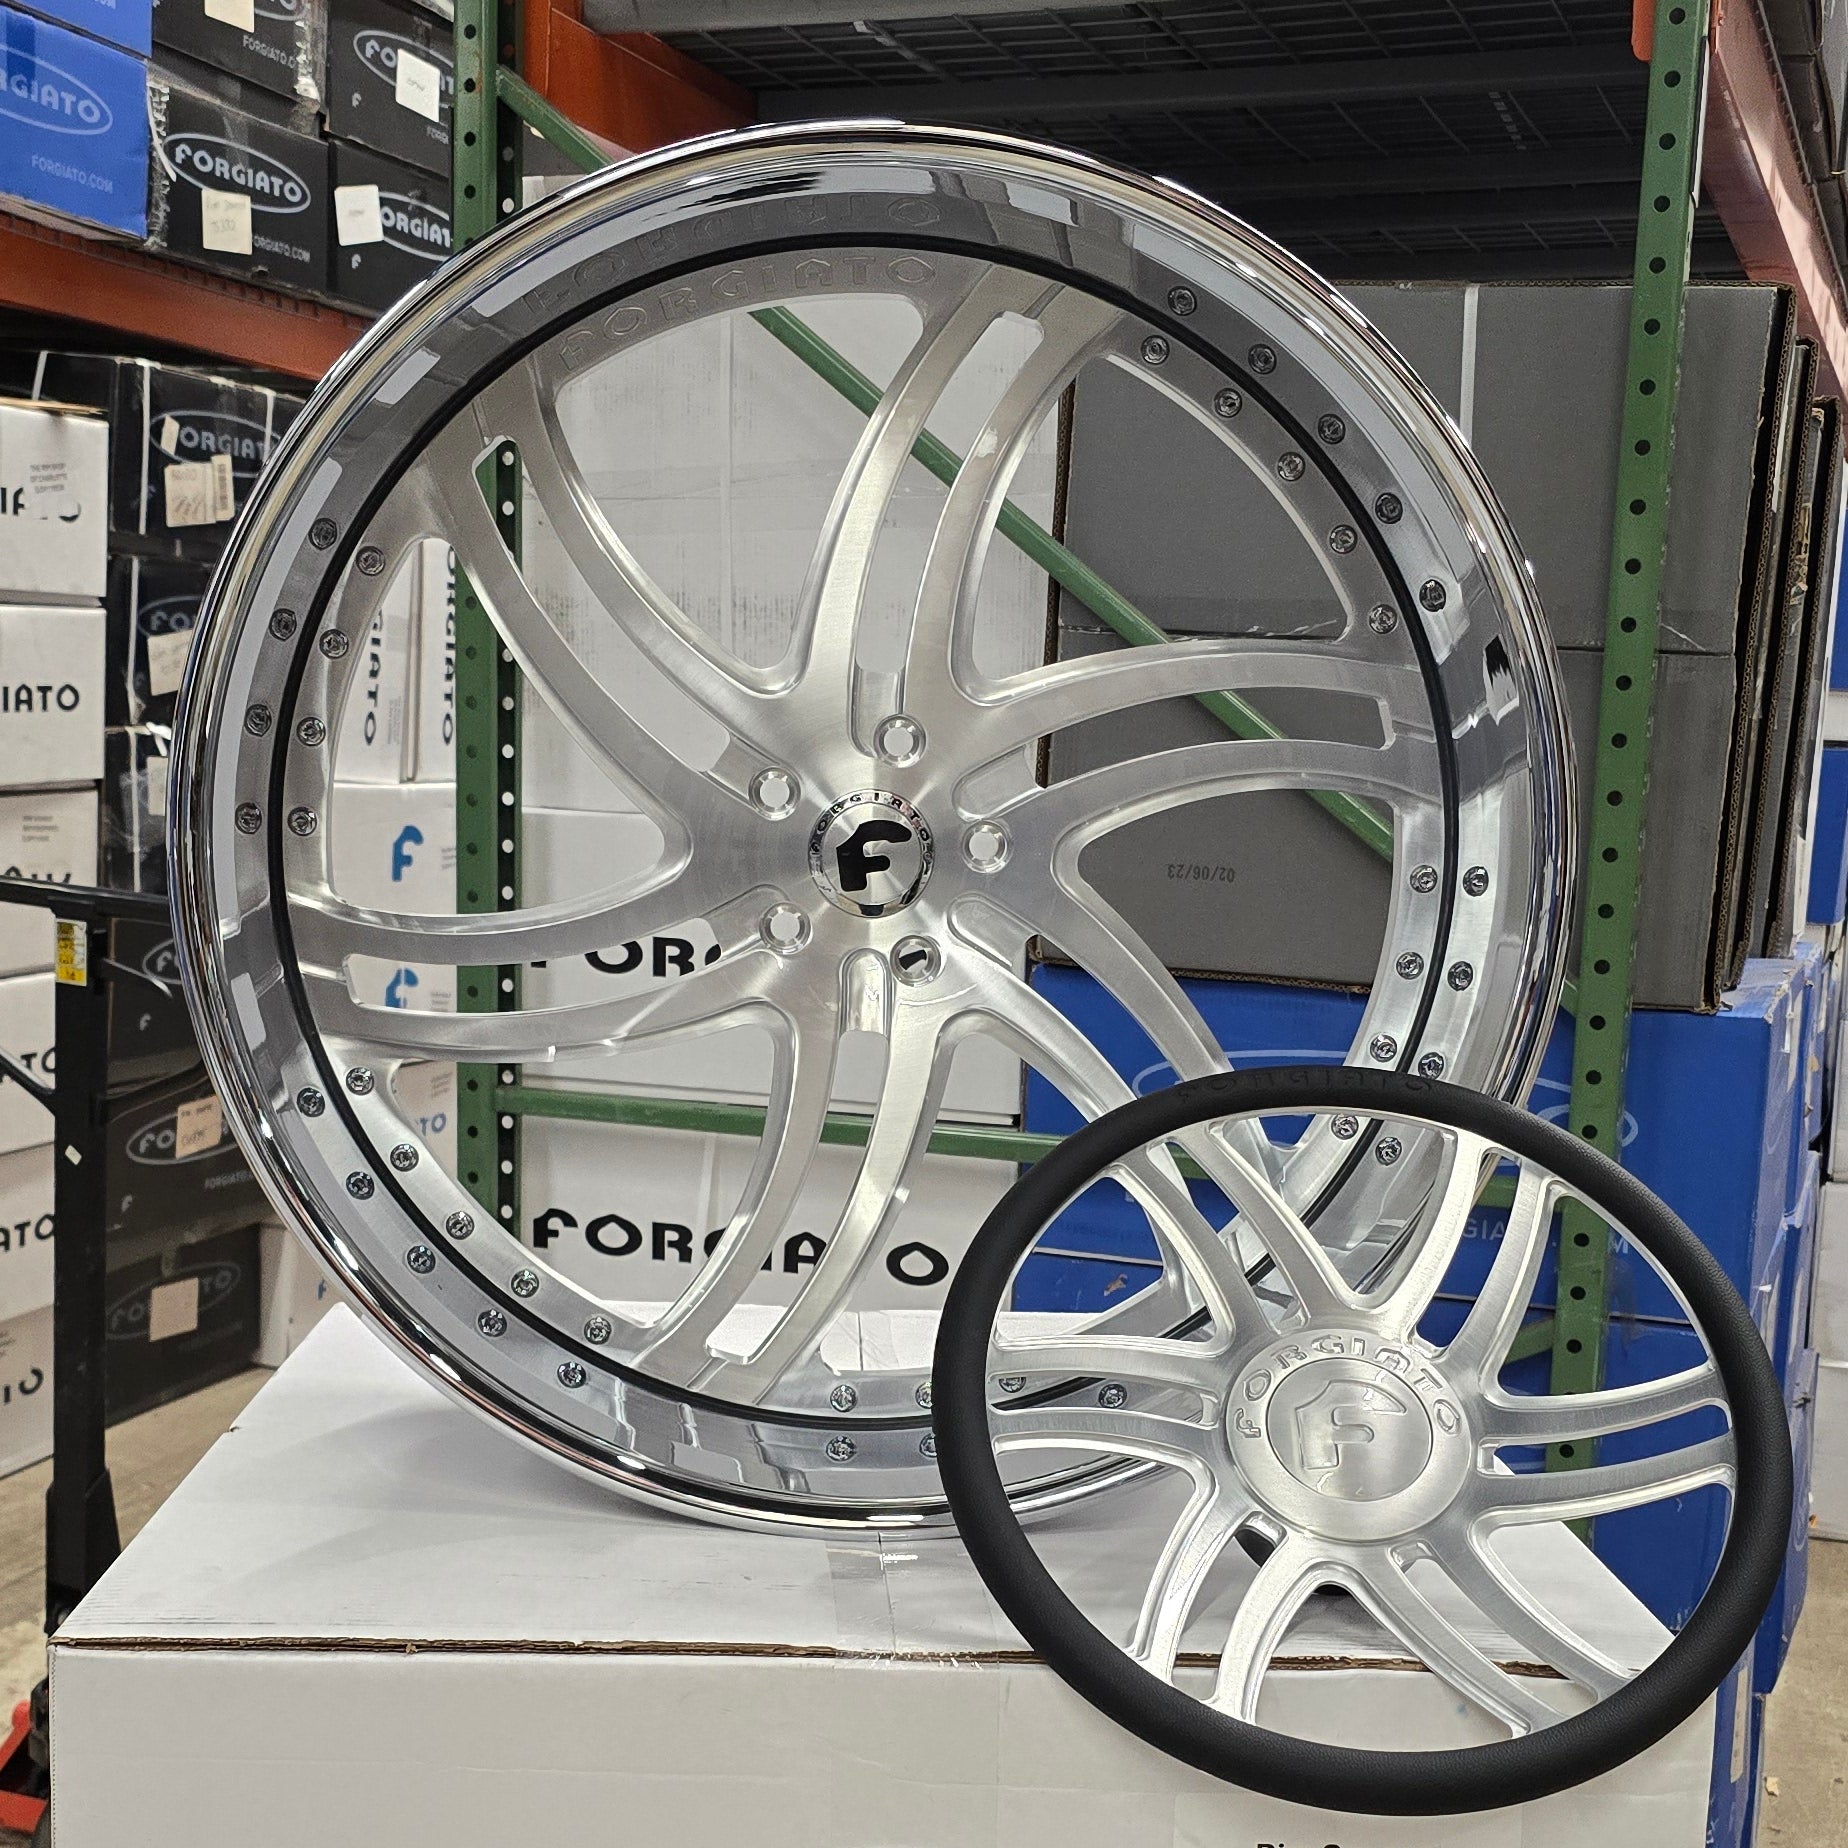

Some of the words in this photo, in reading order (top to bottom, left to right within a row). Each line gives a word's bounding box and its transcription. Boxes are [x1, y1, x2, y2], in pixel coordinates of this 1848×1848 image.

[31, 154, 114, 194] FORGIATO.COM
[175, 144, 303, 203] FORGIATO
[558, 256, 937, 371] FORGIATO
[2, 684, 80, 712] IATO
[391, 824, 424, 882] F
[810, 792, 931, 855] FORGIATO
[836, 819, 912, 892] F
[1167, 863, 1236, 883] 02/06/23
[533, 1208, 949, 1286] FORAO
[1235, 1333, 1462, 1440] FORGIATO
[1294, 1379, 1408, 1471] F
